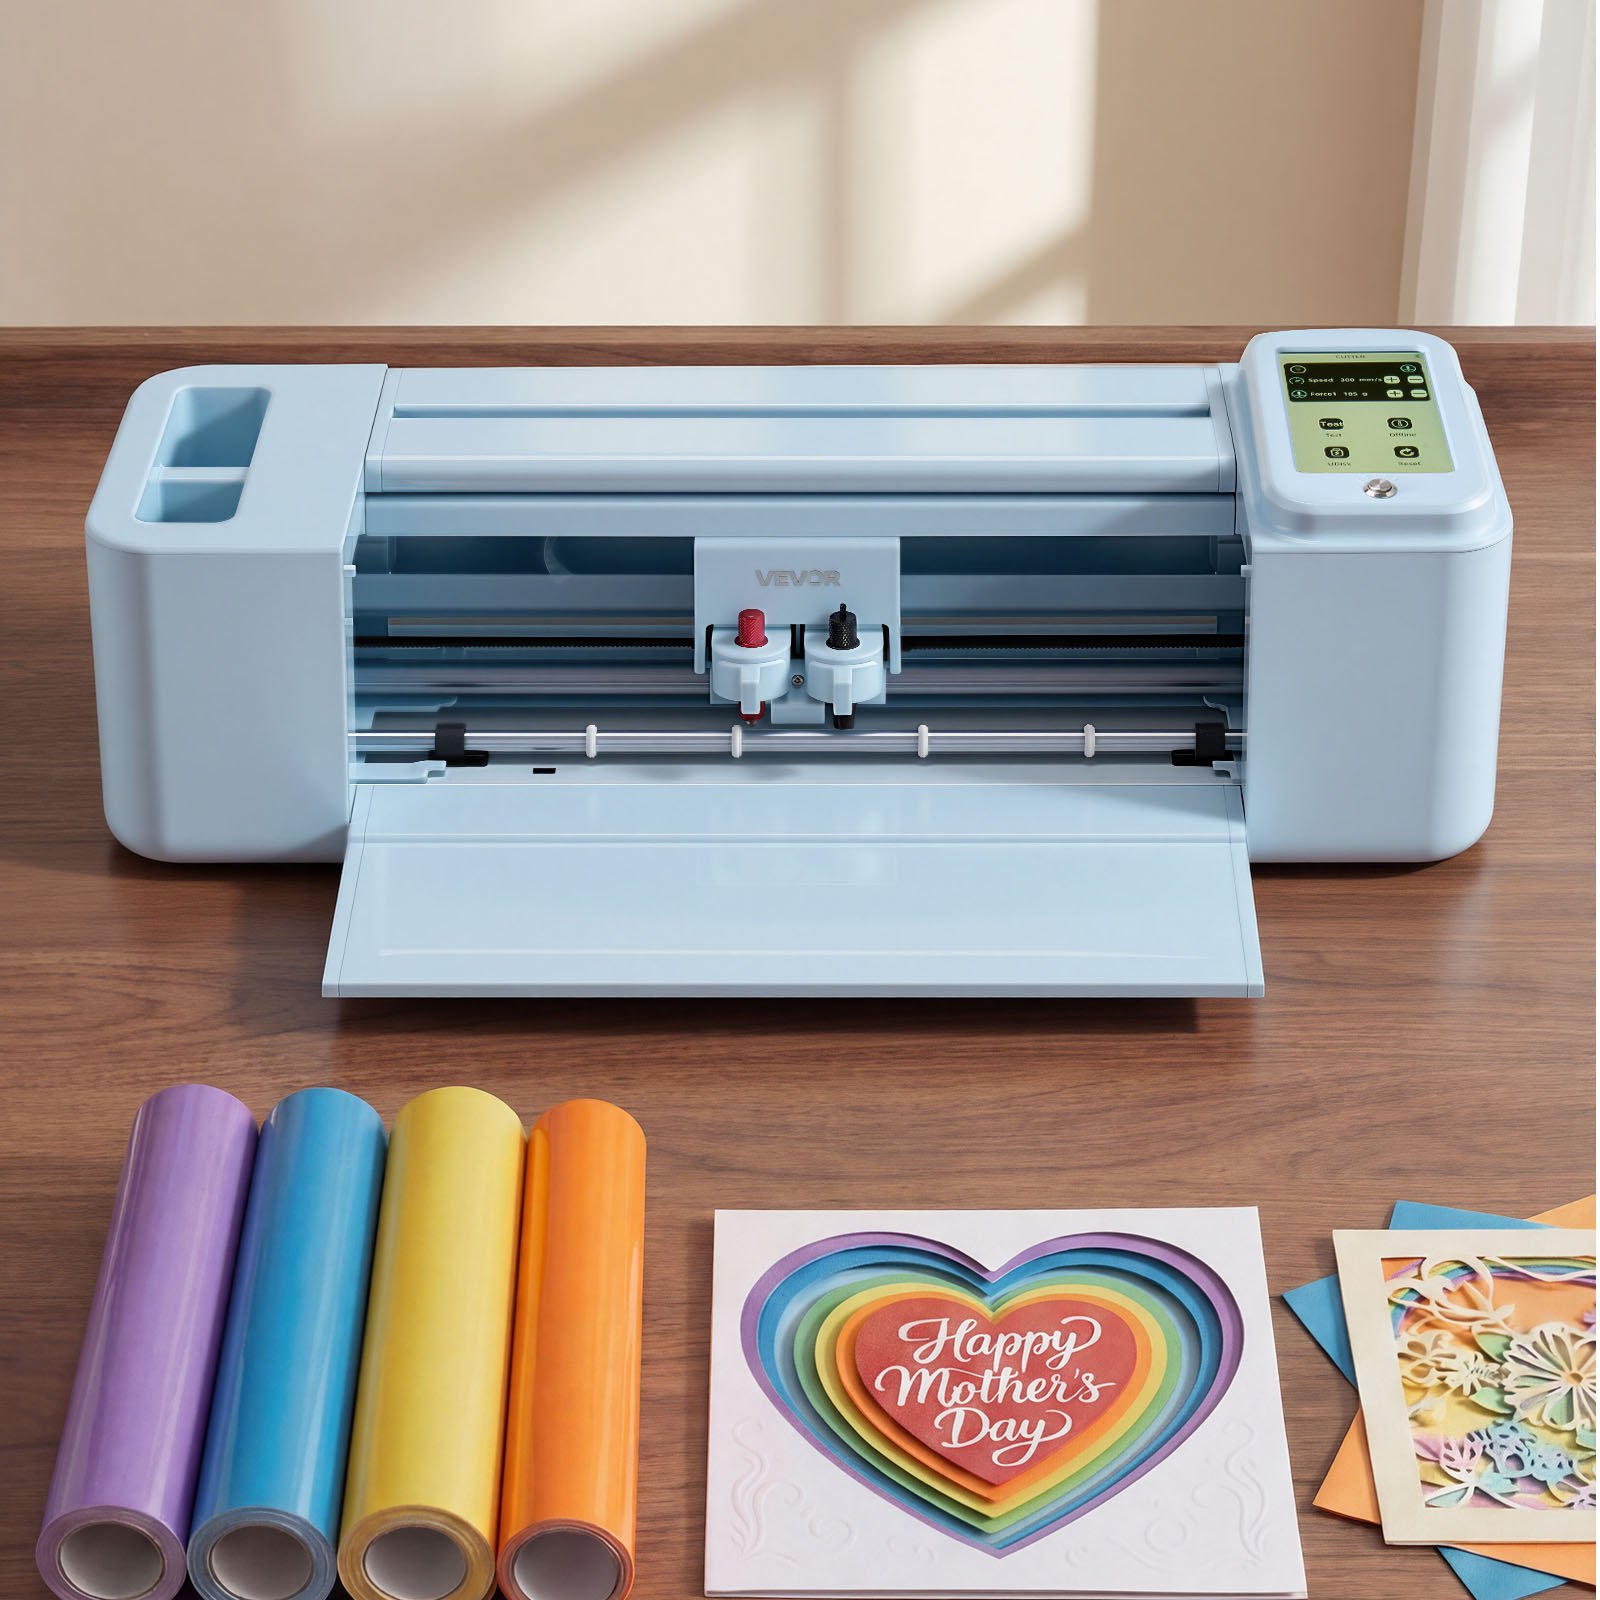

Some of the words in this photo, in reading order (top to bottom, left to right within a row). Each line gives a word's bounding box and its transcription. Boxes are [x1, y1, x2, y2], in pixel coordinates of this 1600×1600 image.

[755, 569, 841, 587] VEVOR
[898, 1315, 1102, 1373] Happy
[874, 1365, 1117, 1408] Mother's
[934, 1407, 1073, 1467] Day
